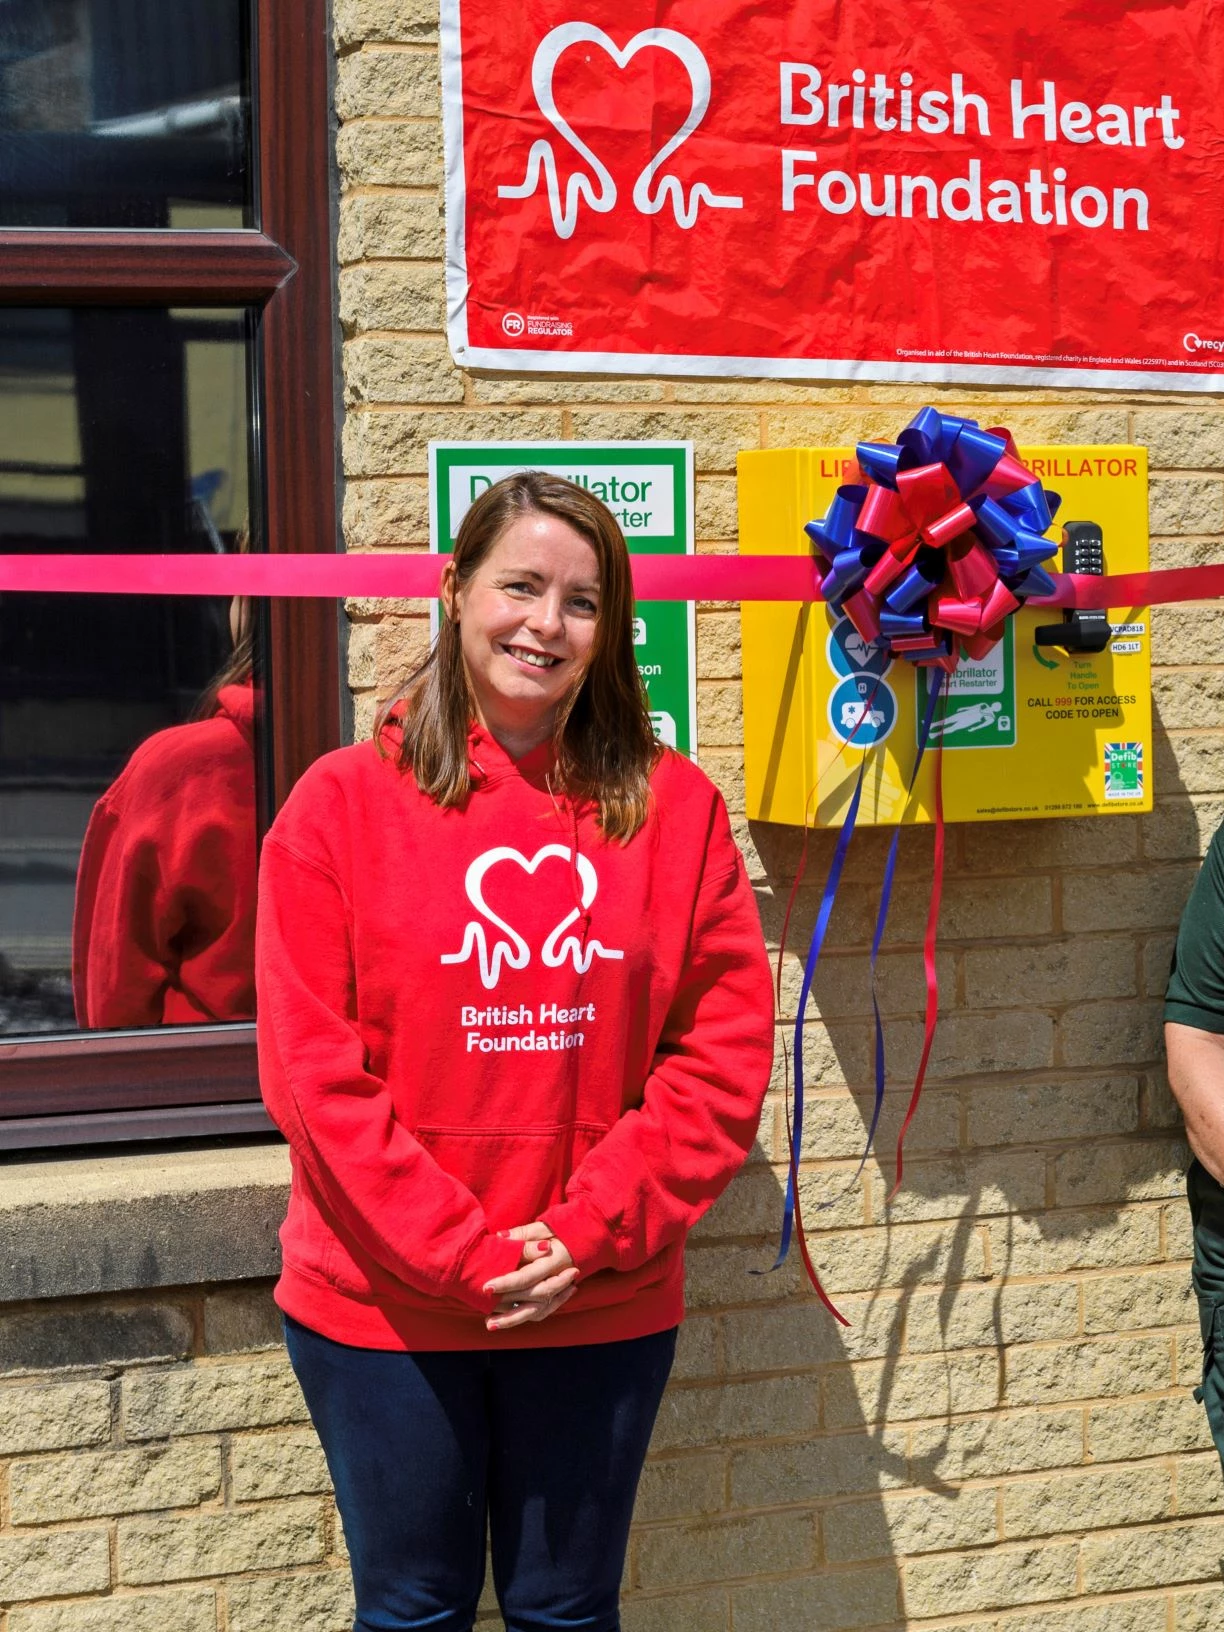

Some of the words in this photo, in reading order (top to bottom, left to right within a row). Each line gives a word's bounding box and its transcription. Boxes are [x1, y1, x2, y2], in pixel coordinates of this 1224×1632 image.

[779, 62, 990, 135] British
[1012, 79, 1184, 149] Heart
[781, 149, 1149, 231] Foundation
[506, 320, 520, 329] FR
[528, 321, 572, 329] FUNDRAISING
[528, 328, 572, 336] REGULATOR
[897, 349, 926, 357] Organised
[1000, 352, 1035, 361] Foundation,
[1063, 355, 1081, 363] charity
[1089, 356, 1112, 364] England
[960, 680, 997, 688] Restarter
[1078, 682, 1099, 690] Open
[1028, 698, 1053, 707] CALL
[1055, 697, 1072, 706] 999
[1074, 696, 1094, 705] FOR
[1096, 695, 1136, 705] ACCESS
[1045, 710, 1073, 719] CODE
[1075, 709, 1090, 718] TO
[1091, 708, 1119, 717] OPEN
[1111, 751, 1136, 761] Defib
[461, 1004, 533, 1027] British
[539, 1003, 595, 1025] Heart
[467, 1030, 584, 1053] Foundation
